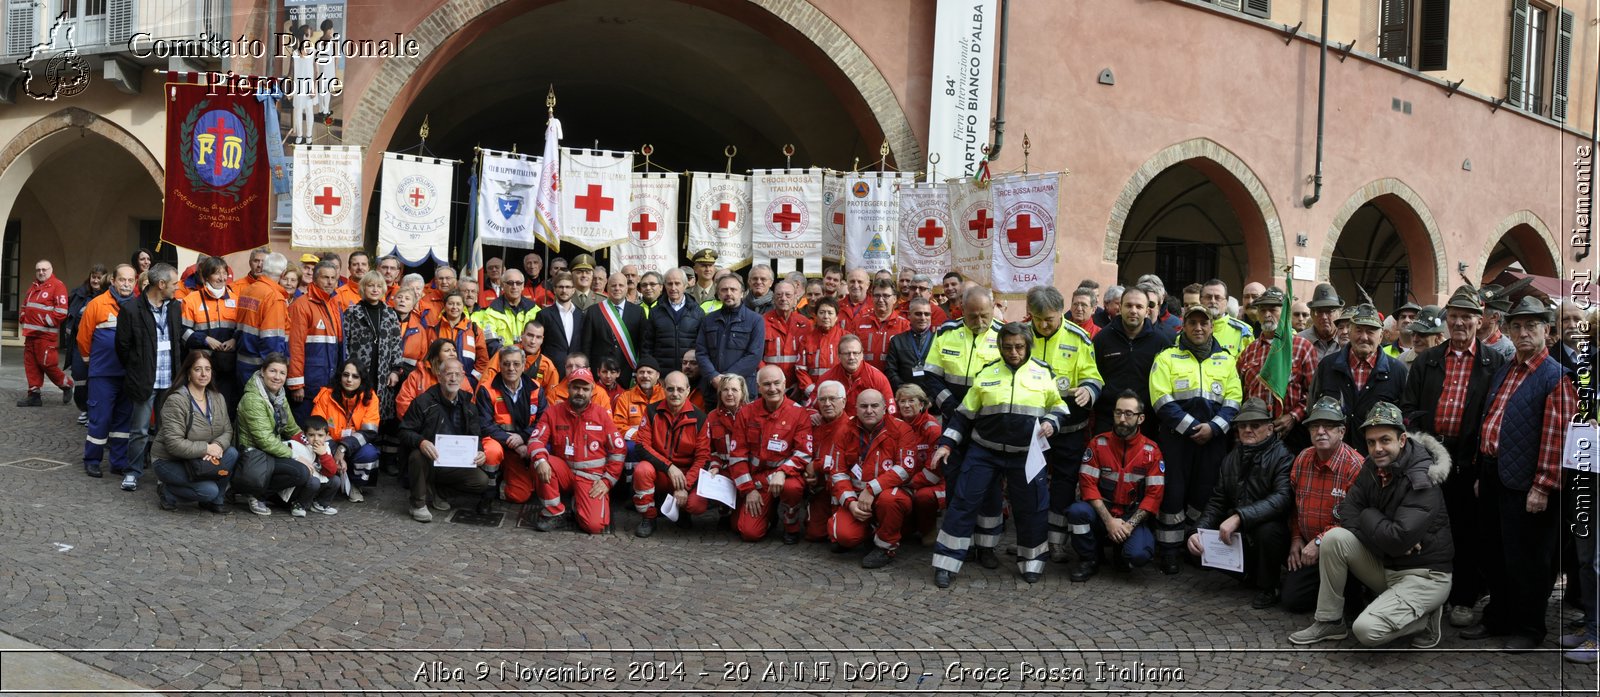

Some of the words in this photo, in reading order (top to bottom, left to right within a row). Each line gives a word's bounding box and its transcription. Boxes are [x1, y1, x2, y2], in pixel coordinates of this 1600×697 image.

[972, 4, 984, 53] D'ALBA
[955, 37, 968, 111] Internazionale
[968, 57, 980, 110] BIANCO
[953, 114, 964, 140] Fiera
[965, 115, 978, 178] TARTUFO
[218, 214, 240, 222] Chiara
[571, 226, 613, 238] SUZZARA
[1013, 274, 1037, 282] ALBA
